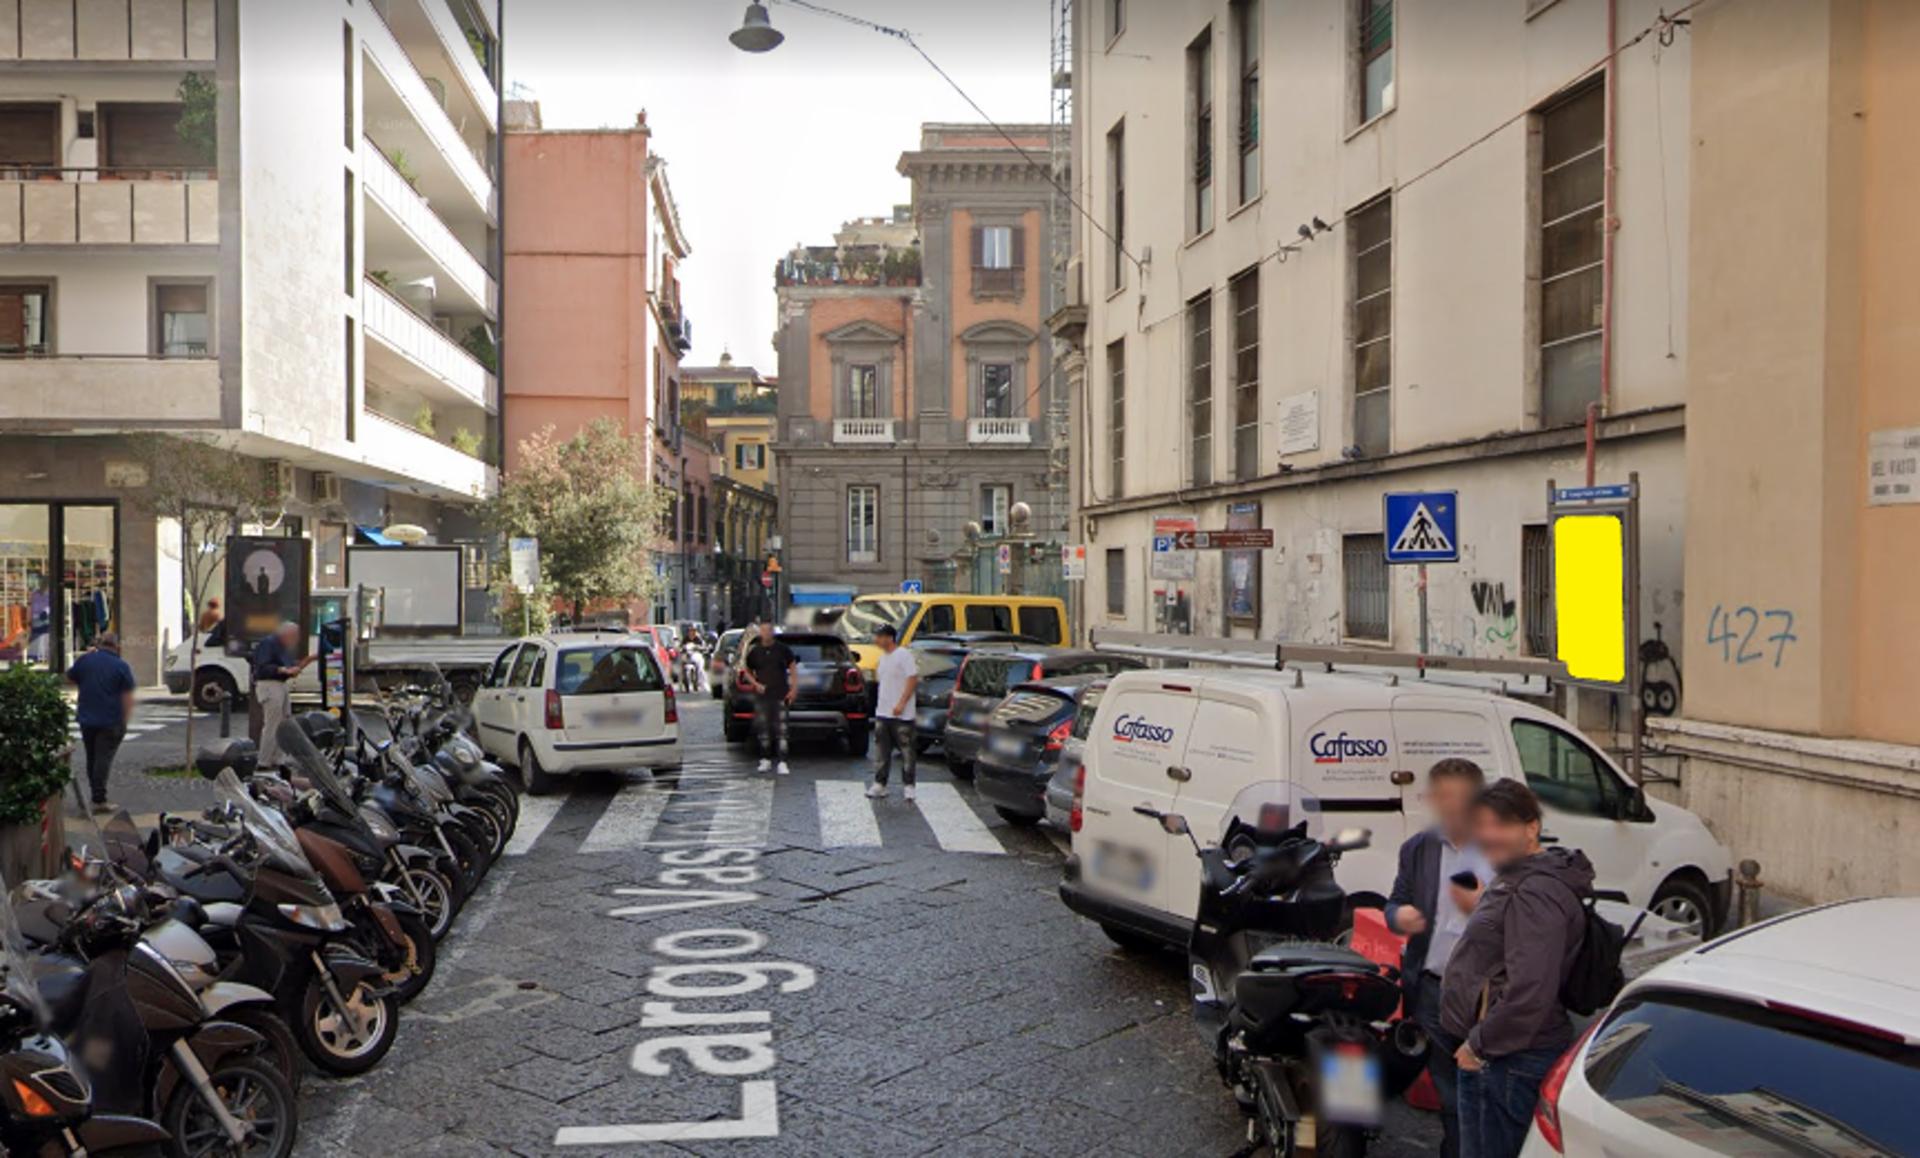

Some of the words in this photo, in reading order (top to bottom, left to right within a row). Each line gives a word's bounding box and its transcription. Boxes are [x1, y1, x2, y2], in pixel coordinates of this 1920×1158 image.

[1708, 605, 1797, 668] 427
[1114, 714, 1173, 743] Cafasso
[1310, 731, 1387, 763] Cafasso
